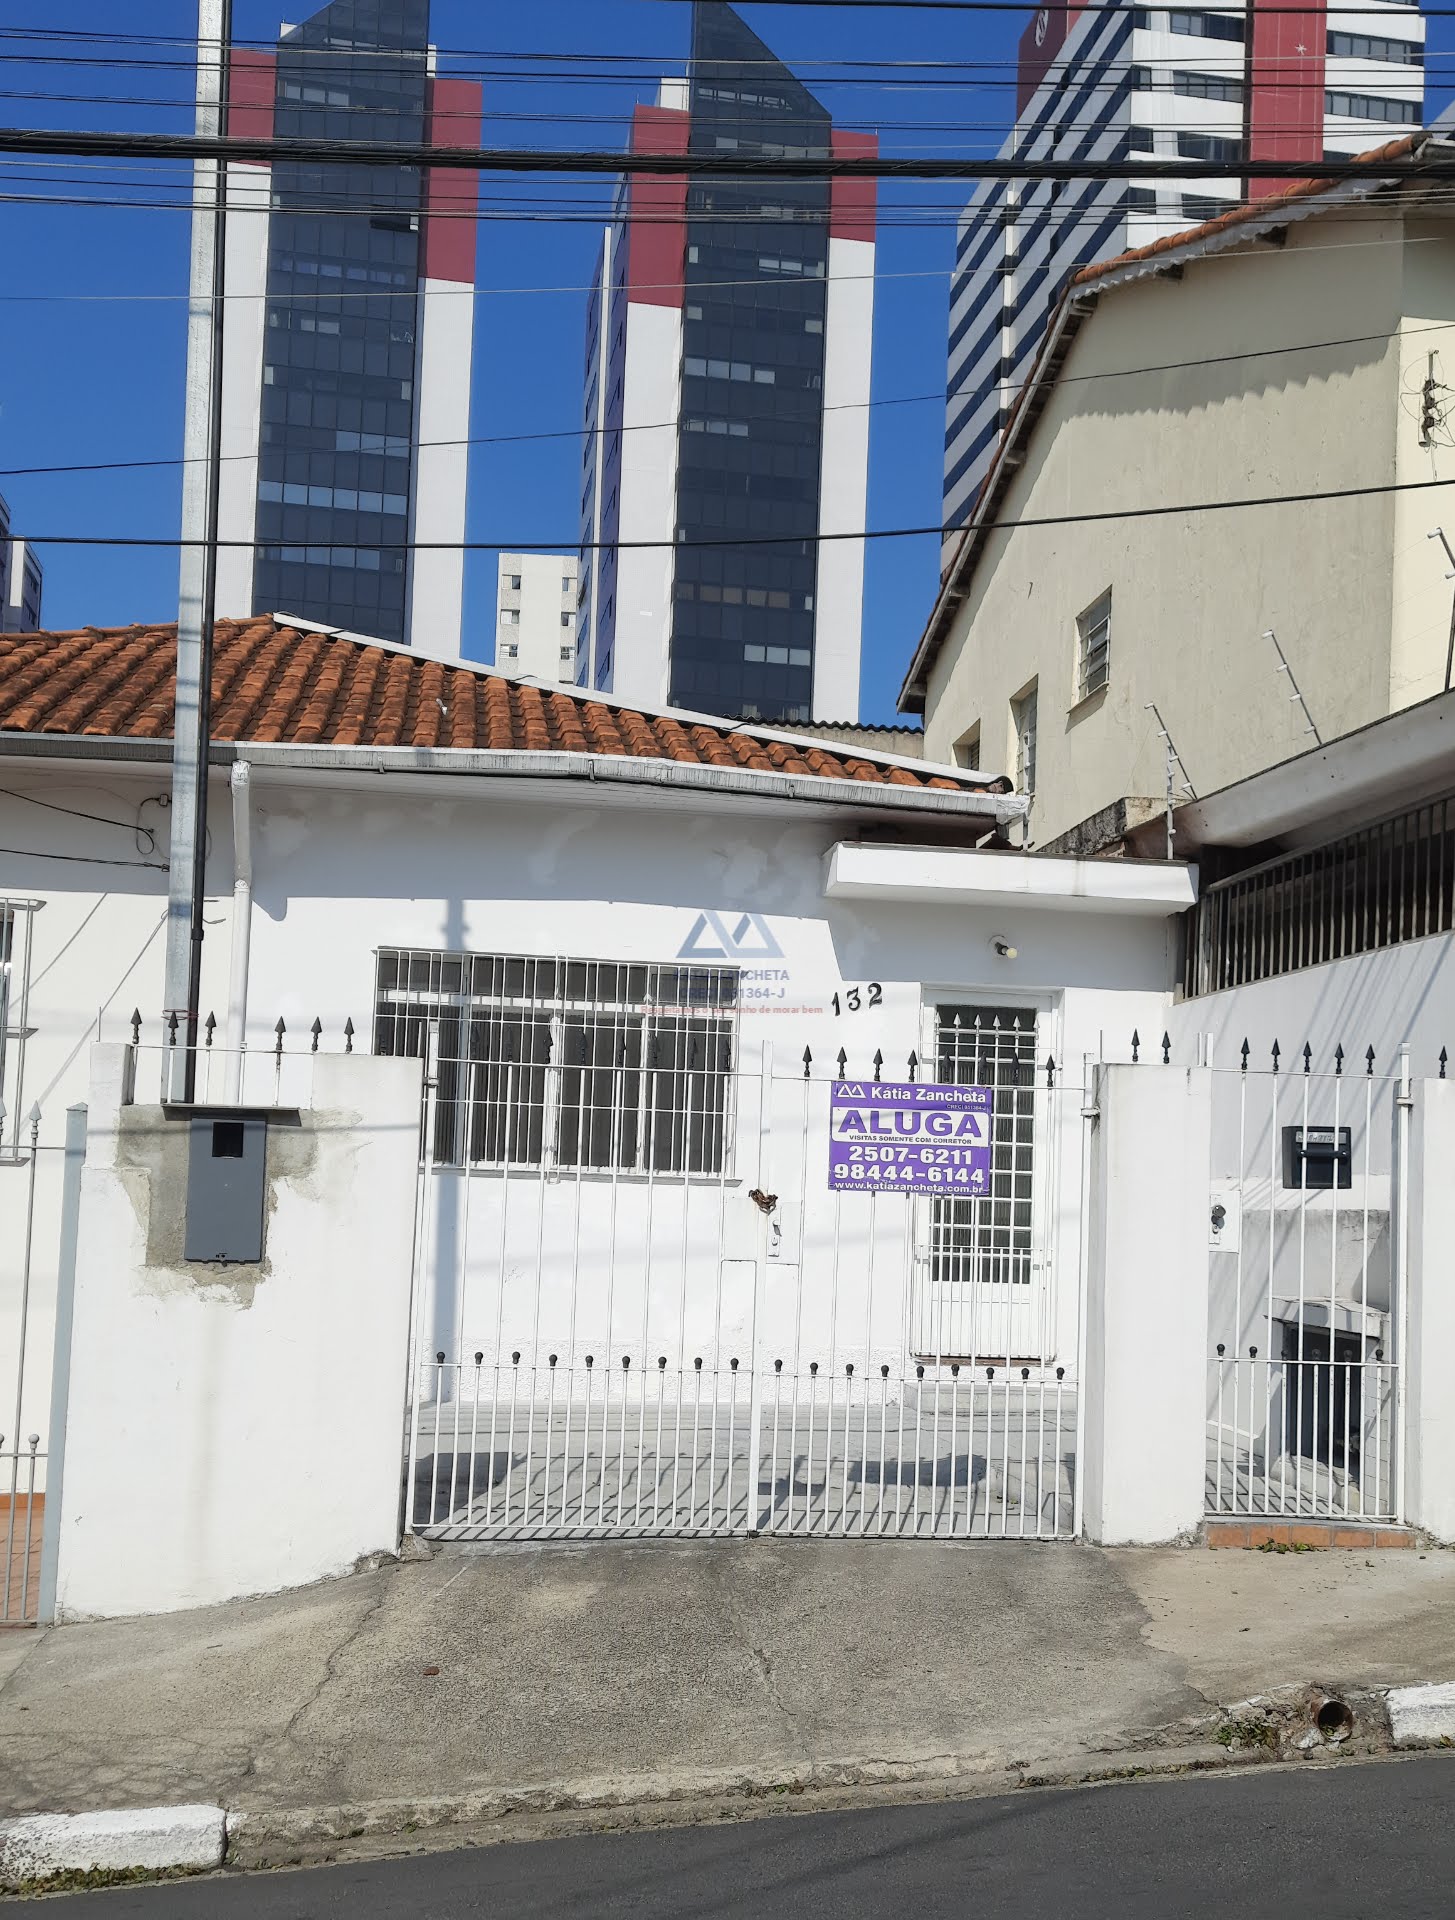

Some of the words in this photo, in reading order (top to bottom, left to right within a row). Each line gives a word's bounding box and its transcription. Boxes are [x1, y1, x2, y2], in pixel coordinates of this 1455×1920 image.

[831, 982, 883, 1017] 132
[871, 1086, 911, 1100] Kátia
[916, 1088, 986, 1103] Zancheta
[838, 1109, 982, 1138] ALUGA
[849, 1134, 877, 1142] VISITAS
[849, 1145, 972, 1165] 2507-6211
[834, 1163, 984, 1184] 98444-6144
[835, 1181, 983, 1193] www.katiazancheta.com.br
